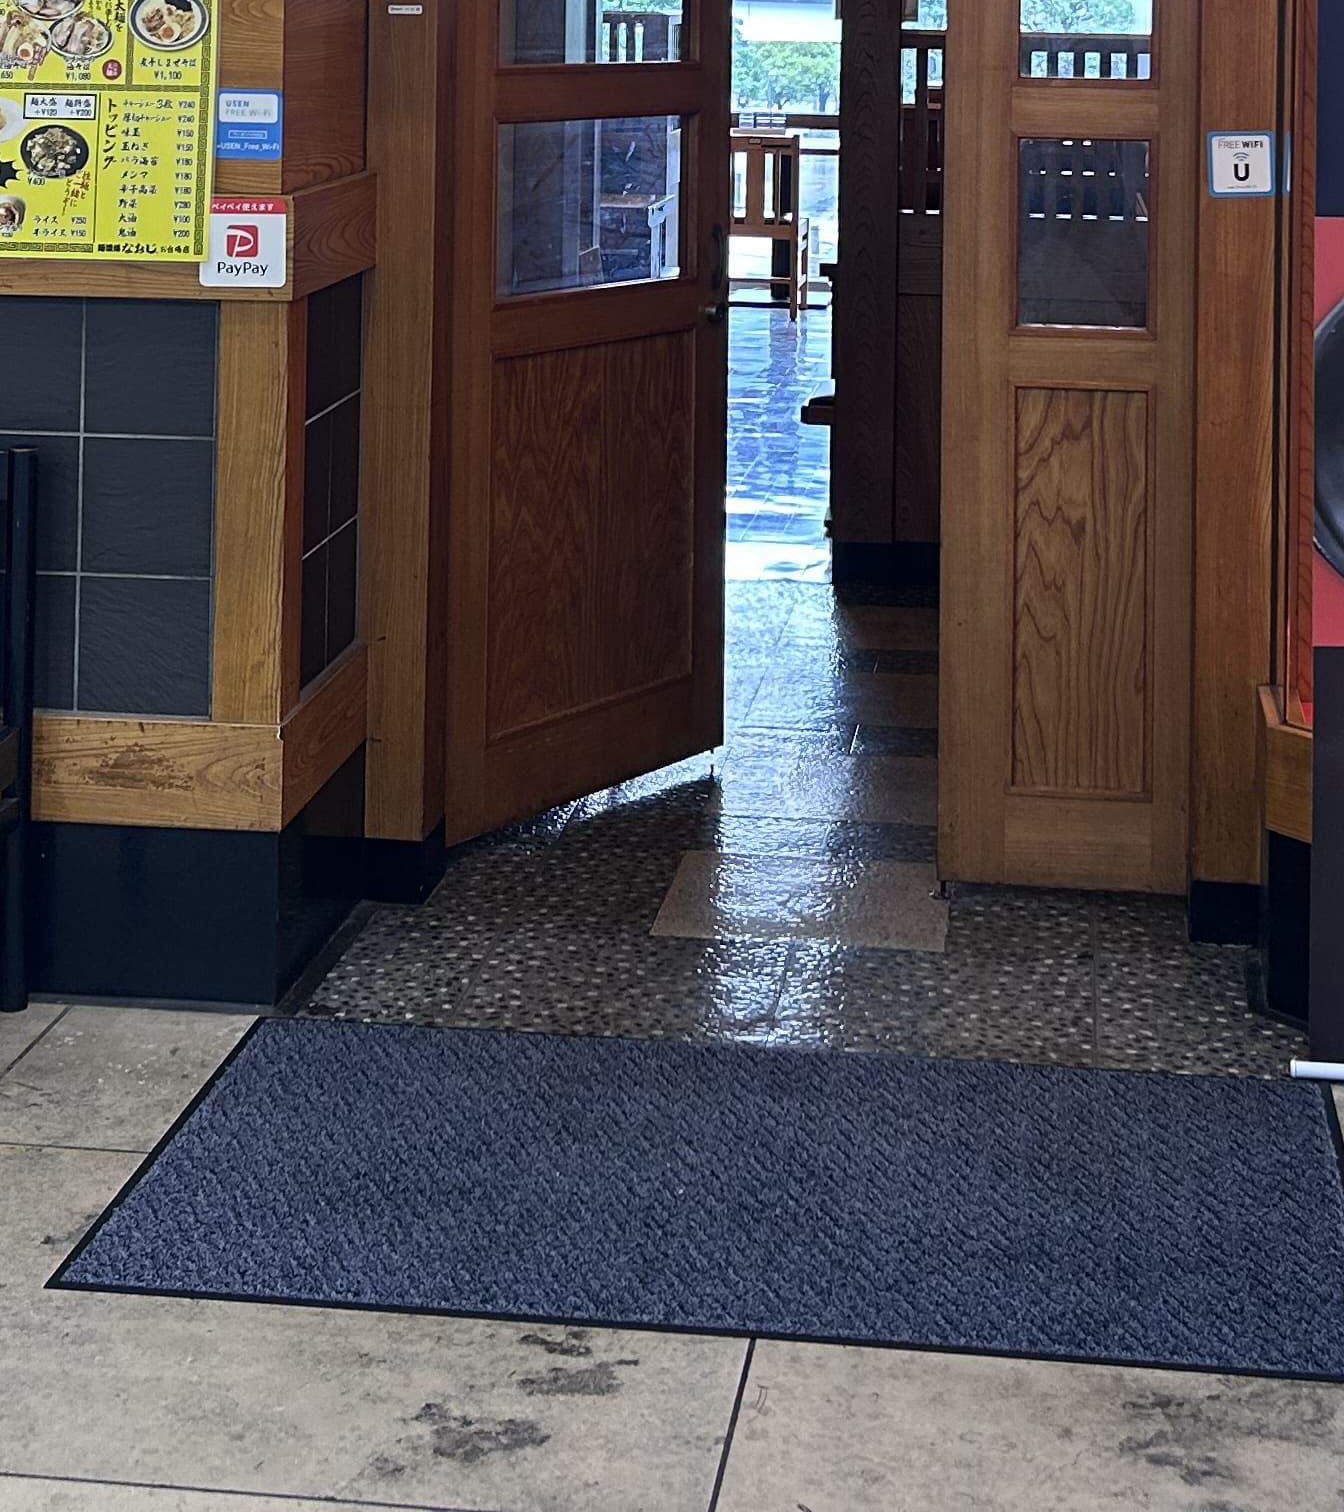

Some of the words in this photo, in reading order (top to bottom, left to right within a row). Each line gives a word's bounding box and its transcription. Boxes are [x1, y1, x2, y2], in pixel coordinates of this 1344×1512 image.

[103, 98, 118, 170] トッピング
[1217, 140, 1241, 149] FREE
[120, 170, 149, 179] メンマ
[217, 261, 269, 276] PayPay
